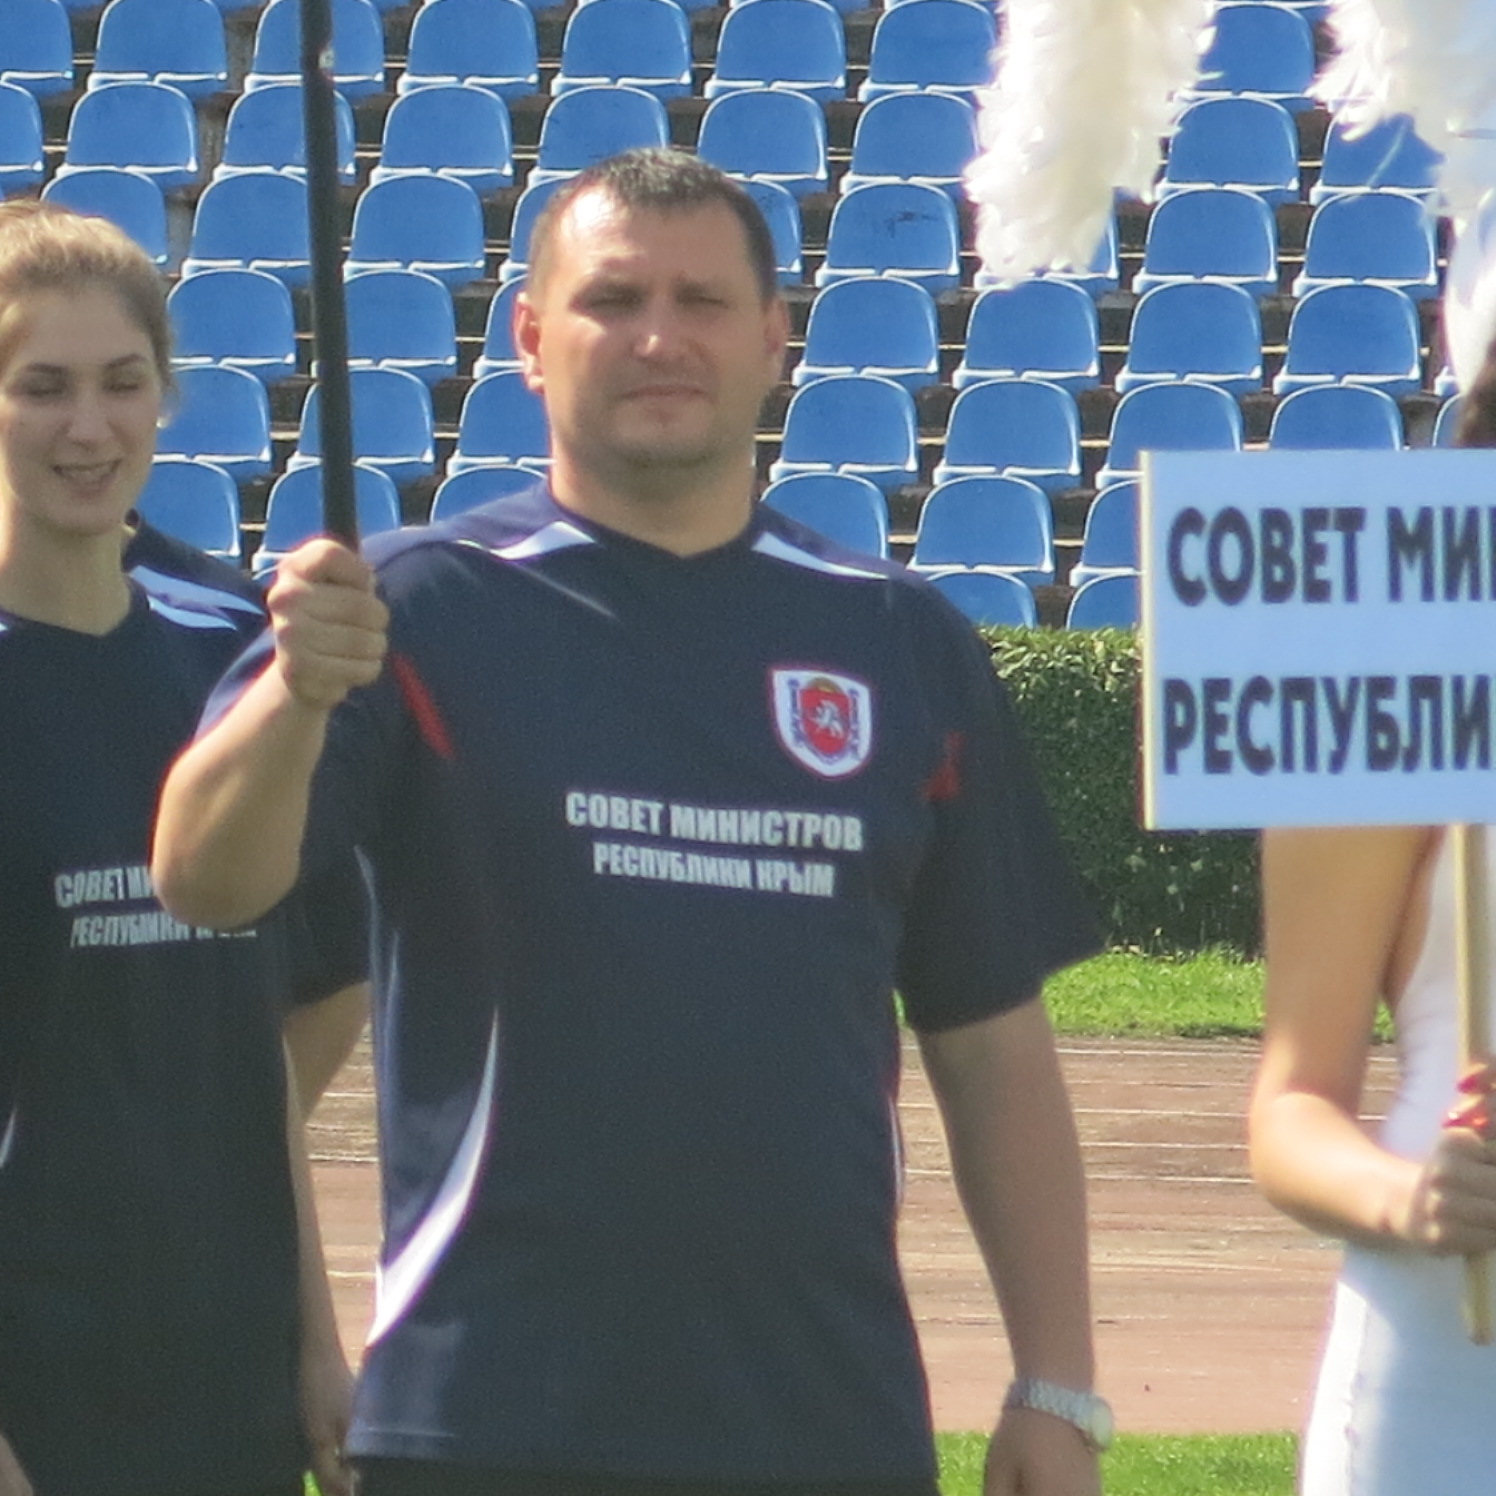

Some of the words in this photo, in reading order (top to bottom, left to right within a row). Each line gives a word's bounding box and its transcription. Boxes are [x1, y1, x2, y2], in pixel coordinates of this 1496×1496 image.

[1167, 506, 1366, 605] СОВЕТ
[1386, 505, 1496, 602] МИ
[1163, 675, 1491, 775] РЕСПУБЛИ
[565, 791, 663, 835] СОВЕТ
[669, 804, 864, 852] МИНИСТРОВ
[55, 868, 124, 907] СОВЕТ
[593, 842, 753, 890] РЕСПУБЛИКИ
[756, 858, 835, 897] КРЫМ
